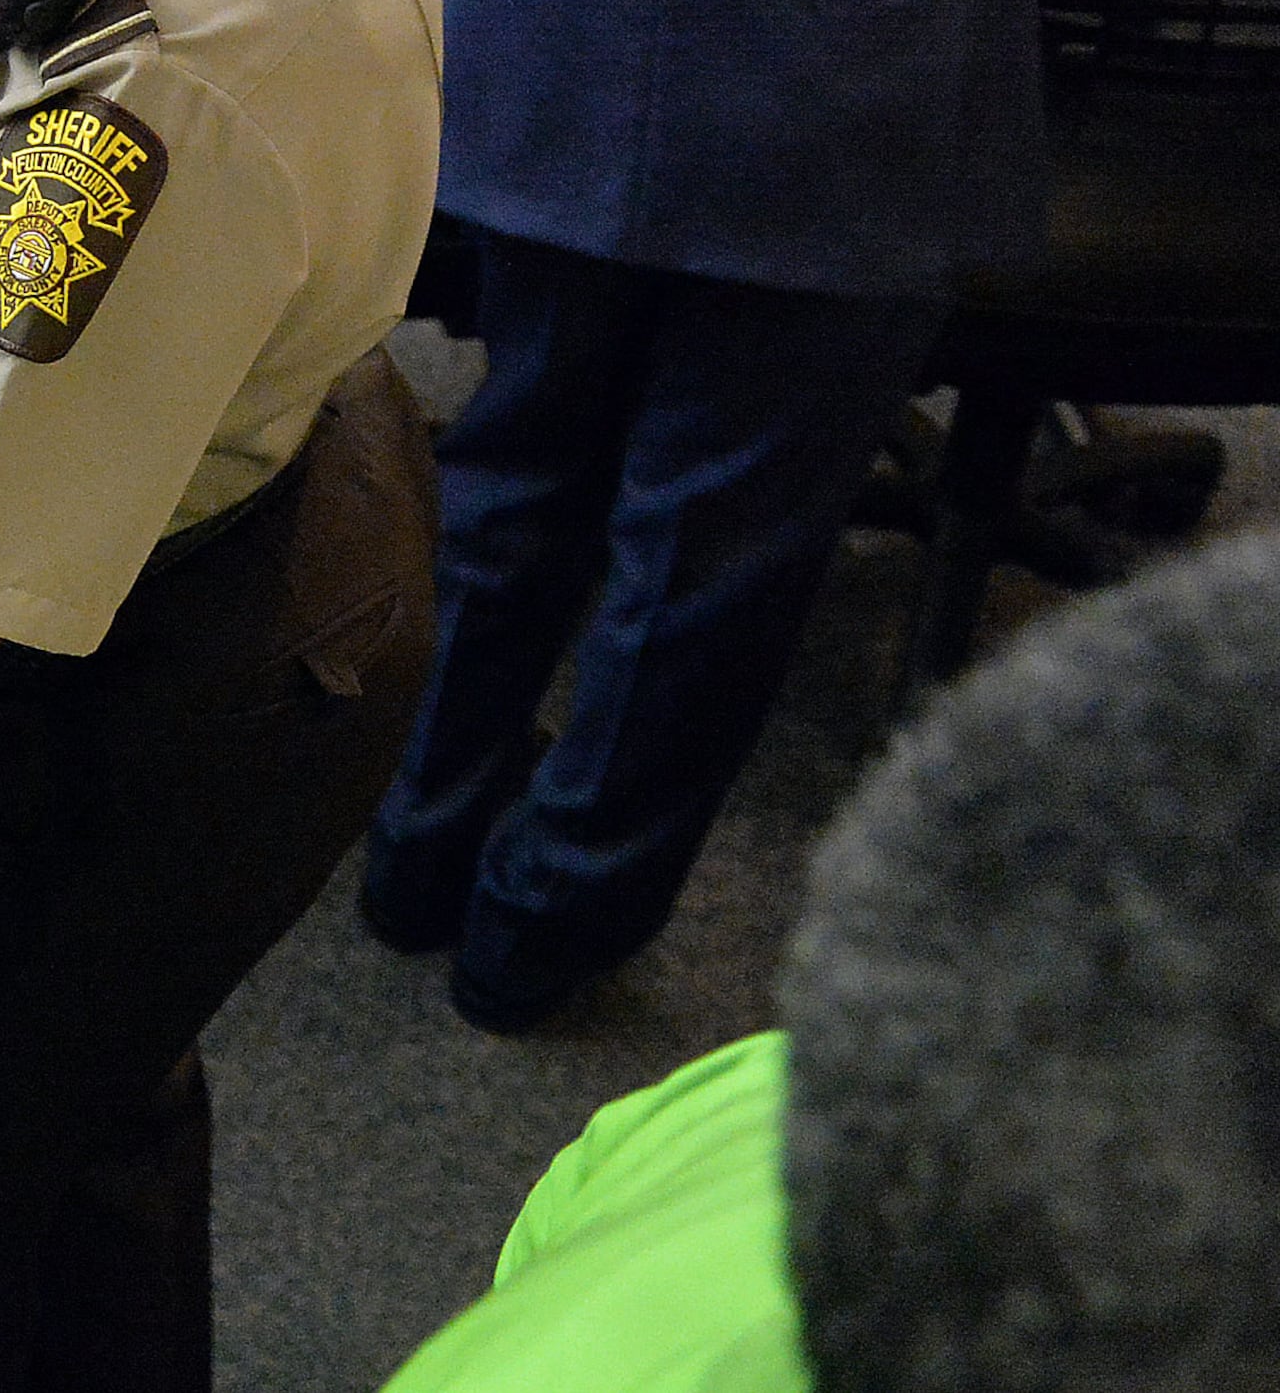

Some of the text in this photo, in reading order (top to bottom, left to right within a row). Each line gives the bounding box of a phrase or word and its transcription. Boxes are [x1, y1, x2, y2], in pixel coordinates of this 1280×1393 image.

[26, 108, 148, 174] SHERIFF
[16, 152, 122, 207] FULTON COUNTY
[27, 201, 72, 225] DEPUTY
[16, 266, 62, 293] COUNTY
